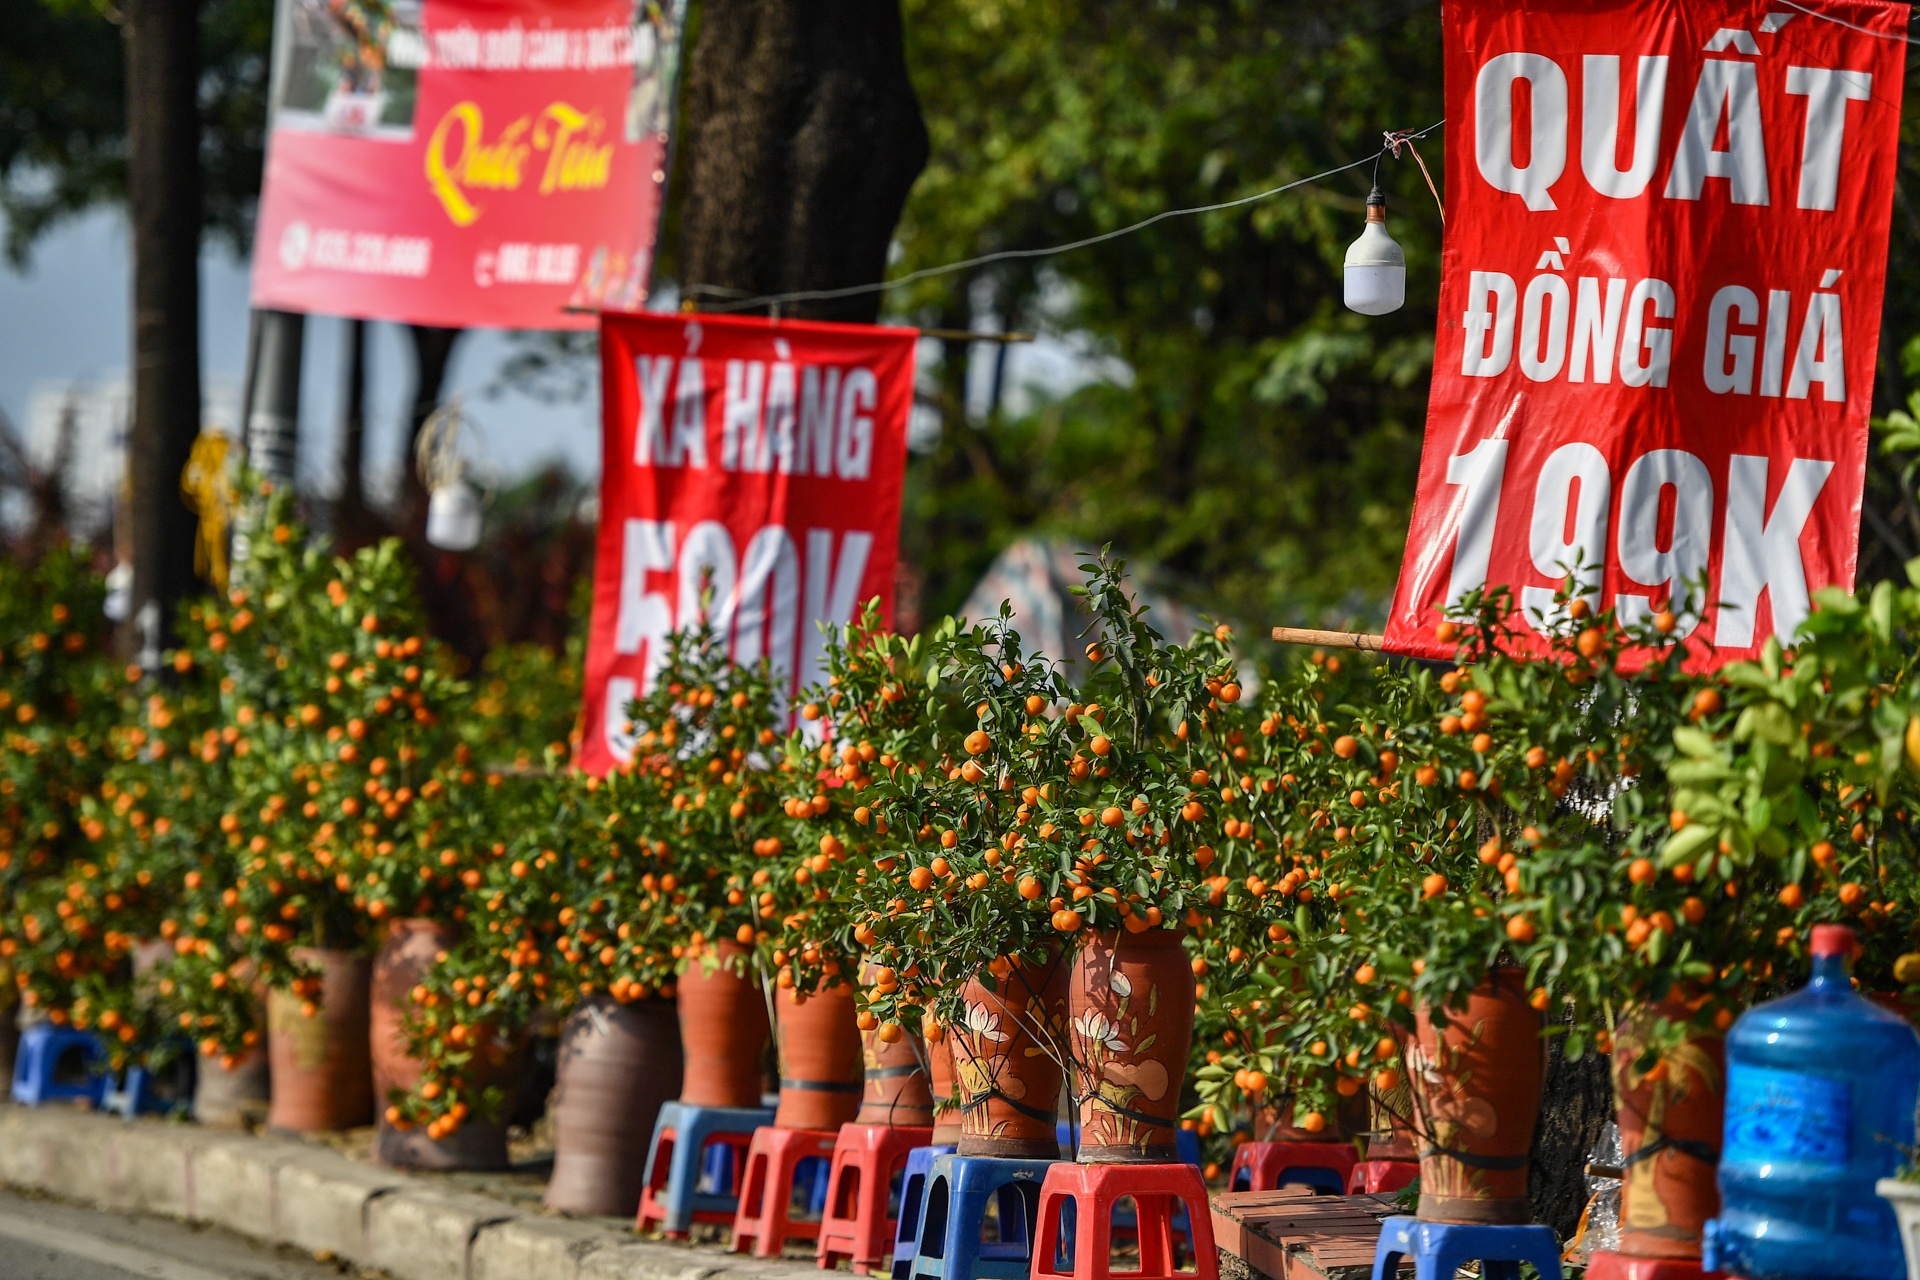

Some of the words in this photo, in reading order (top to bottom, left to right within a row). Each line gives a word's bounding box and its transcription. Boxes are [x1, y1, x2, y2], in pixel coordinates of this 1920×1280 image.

[1474, 12, 1874, 212] QUẤT
[632, 322, 708, 469] XẢ
[721, 338, 879, 481] HÀNG
[1461, 236, 1676, 390] ĐỒNG
[1703, 268, 1847, 403] GIÁ
[1442, 437, 1836, 649] 199K
